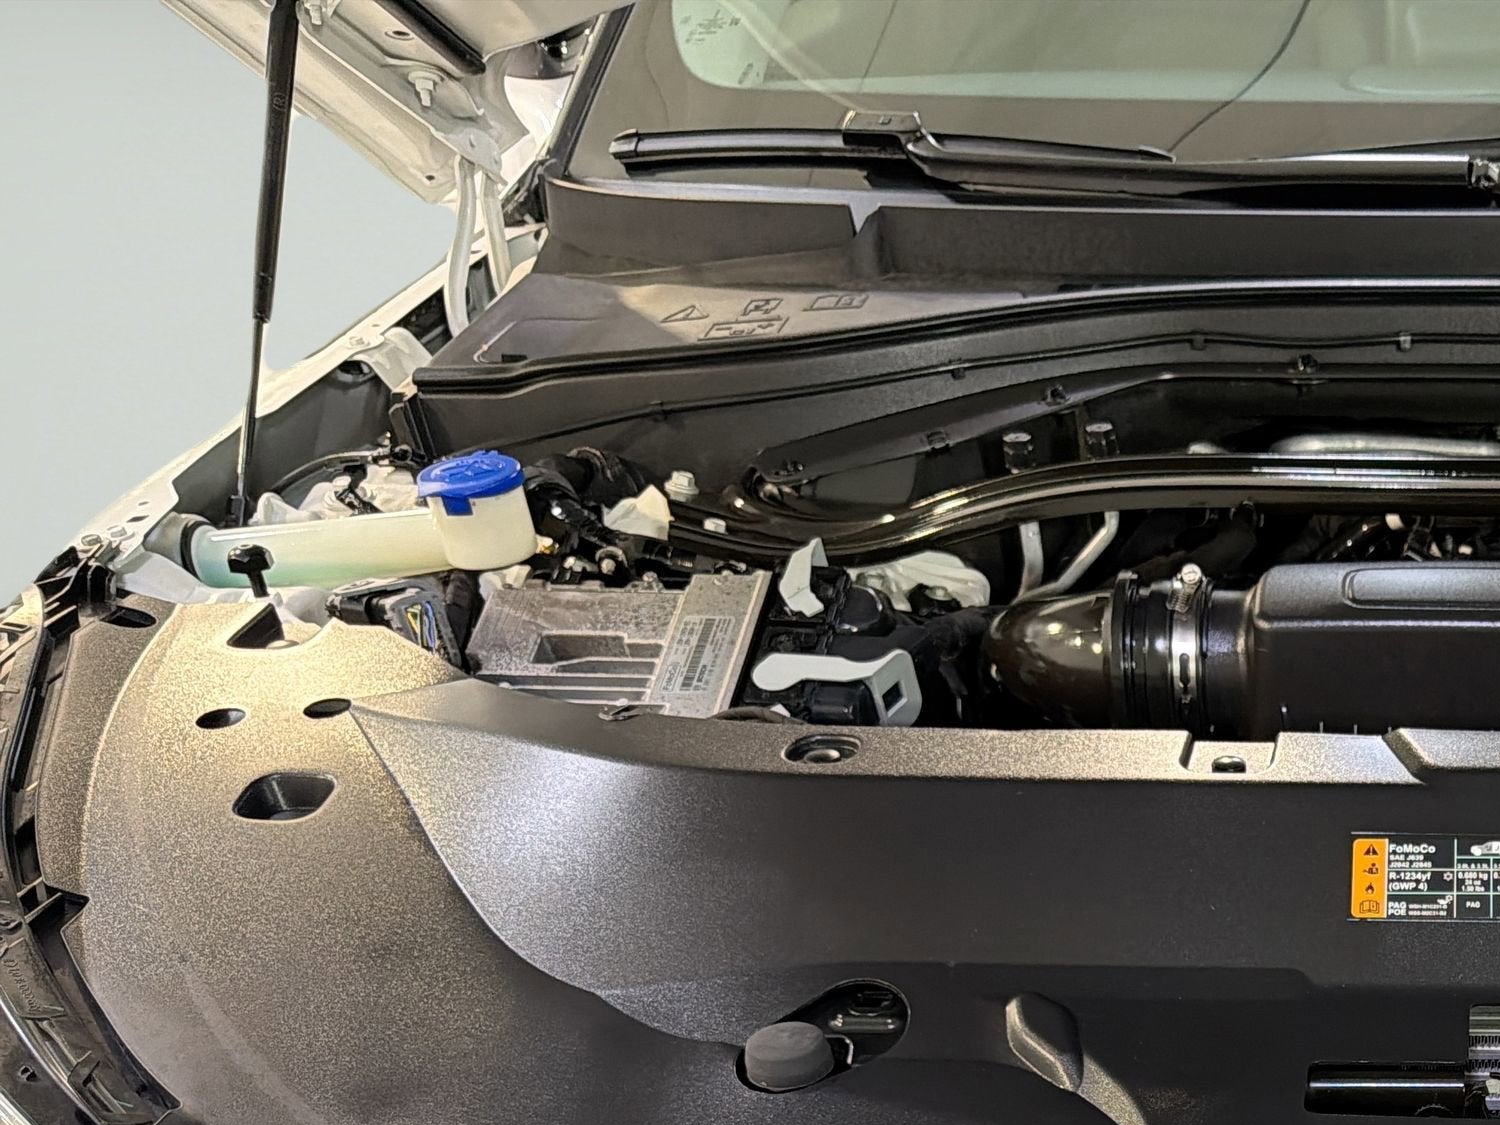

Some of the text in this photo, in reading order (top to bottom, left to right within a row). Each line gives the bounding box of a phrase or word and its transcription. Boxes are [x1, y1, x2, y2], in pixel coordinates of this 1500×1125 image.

[1389, 843, 1436, 853] FoMoCo
[1389, 872, 1431, 881] R-1234yf
[1478, 872, 1488, 880] kg
[1388, 882, 1428, 891] (GWP 4)
[1388, 901, 1407, 909] PAG
